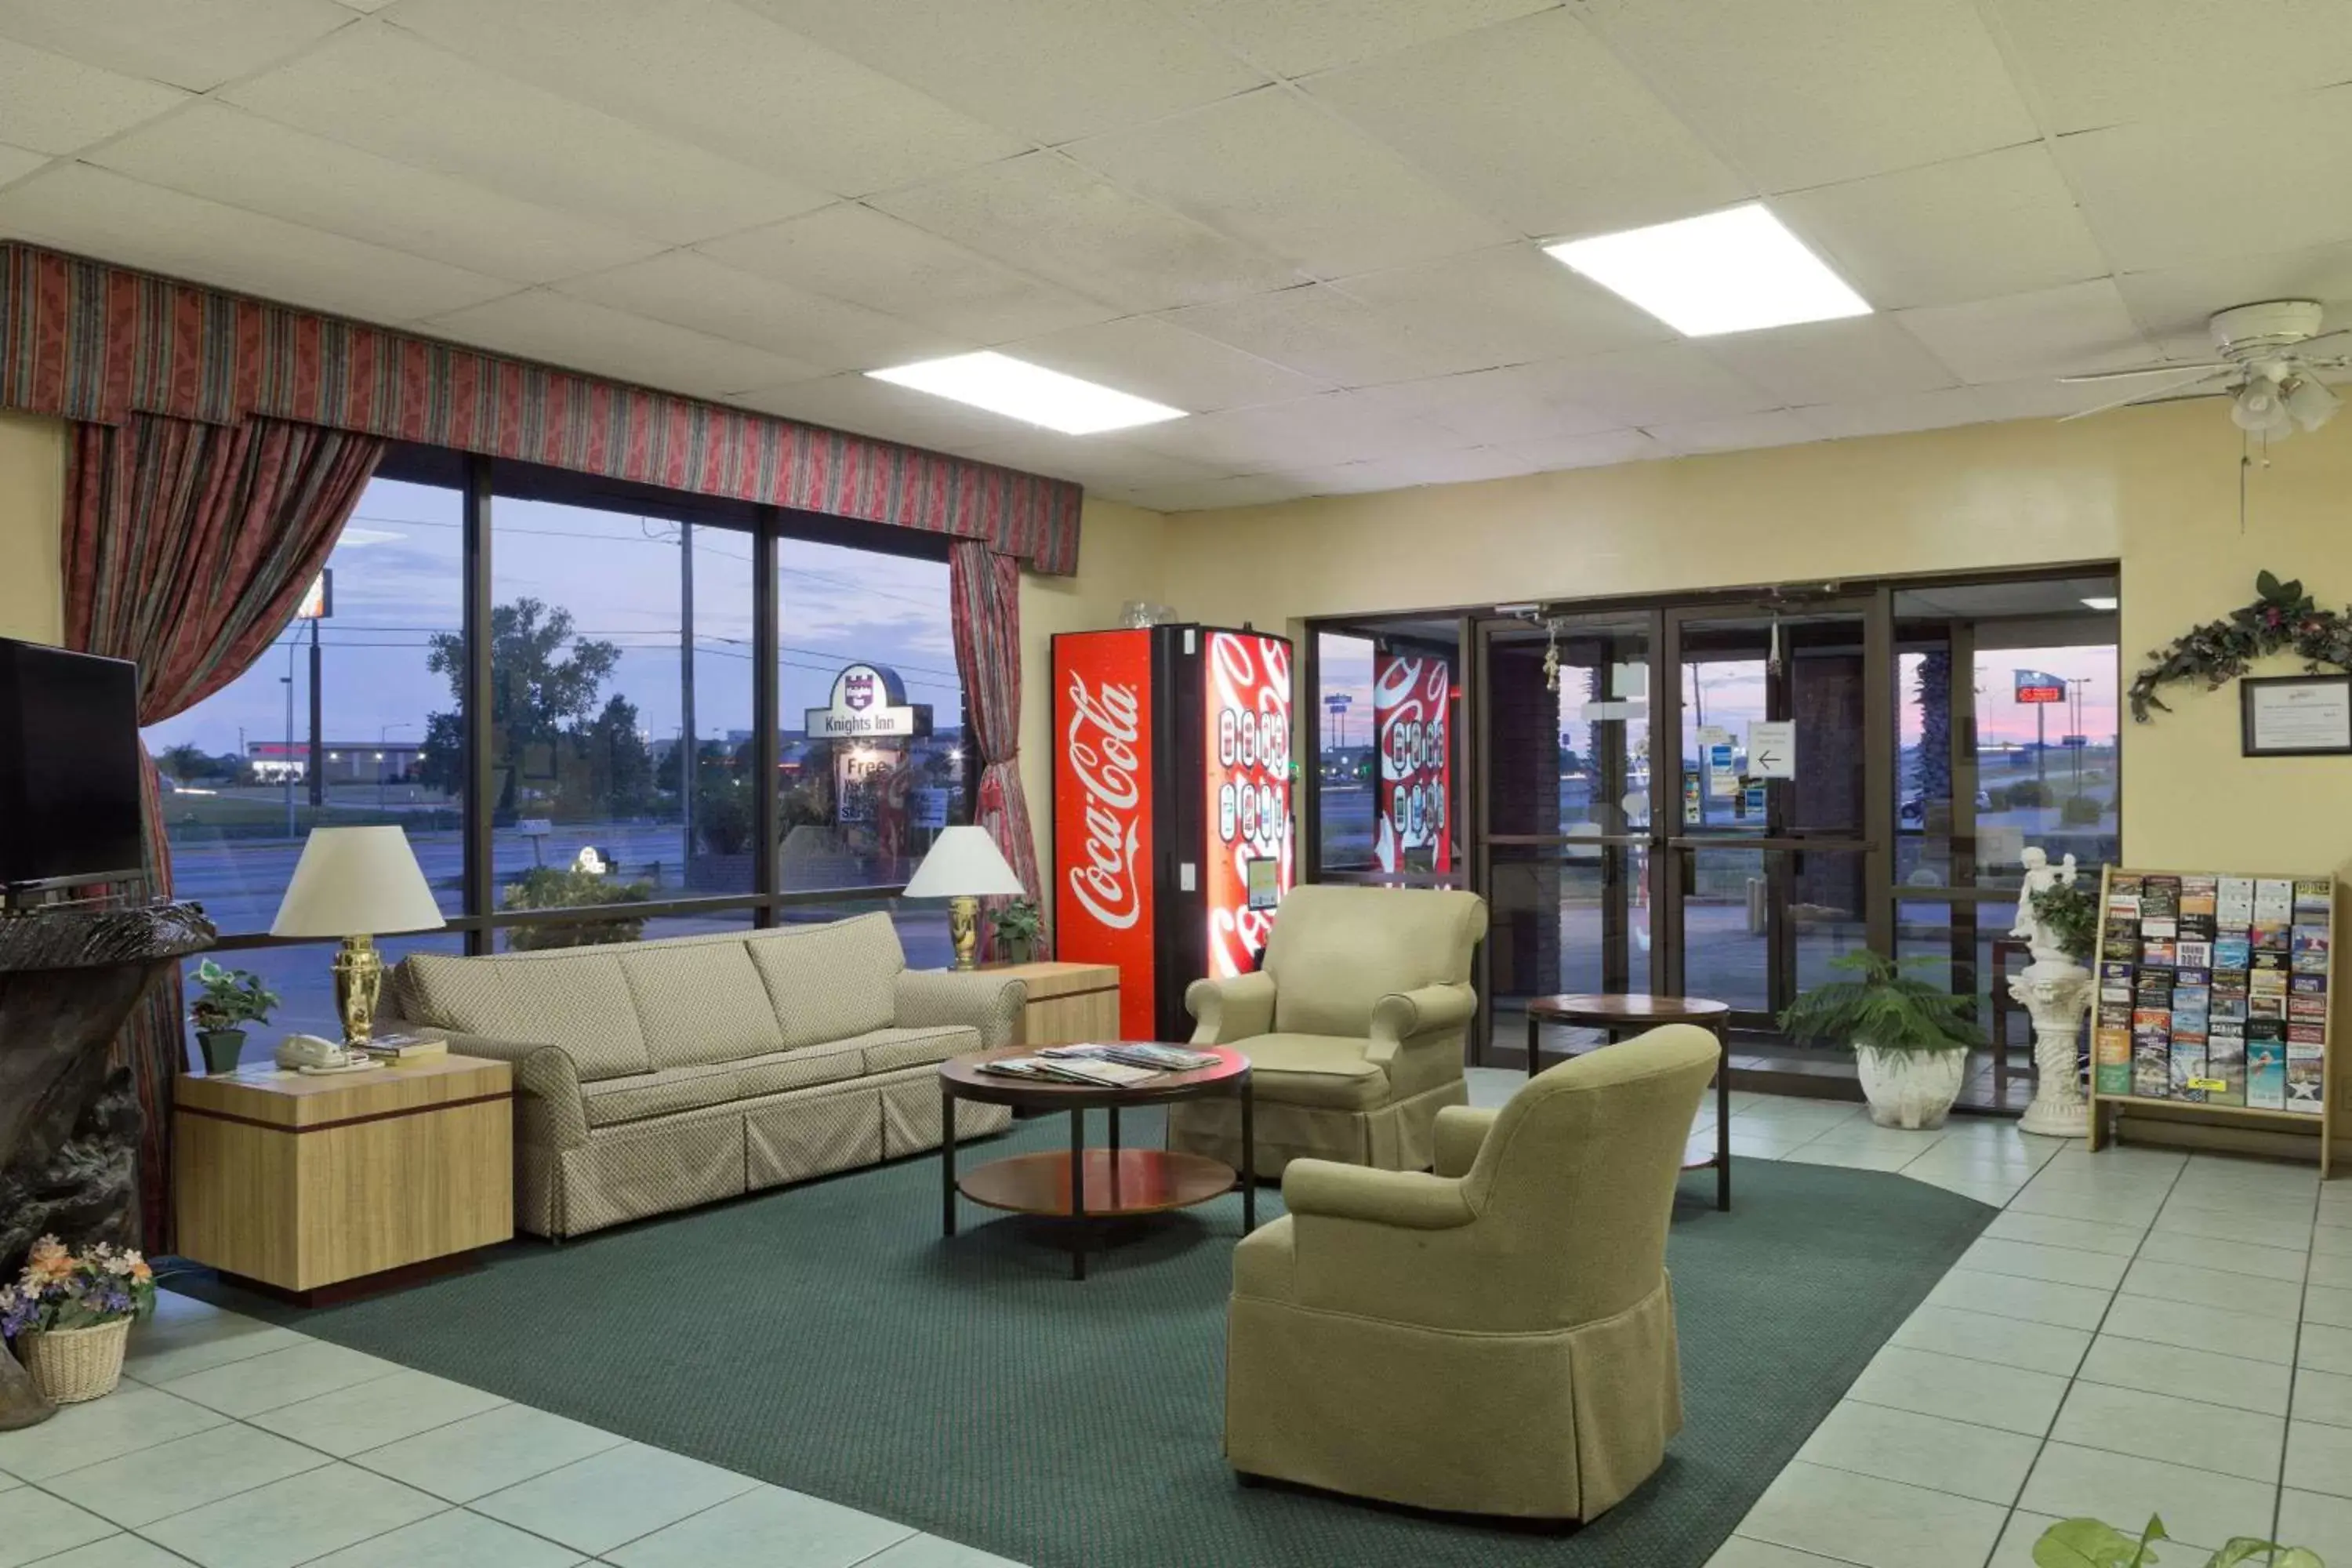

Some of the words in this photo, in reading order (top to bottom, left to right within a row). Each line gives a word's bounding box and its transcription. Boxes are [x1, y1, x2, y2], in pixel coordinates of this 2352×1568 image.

[826, 716, 871, 735] Knights
[875, 714, 895, 730] Inn
[848, 757, 887, 775] Free
